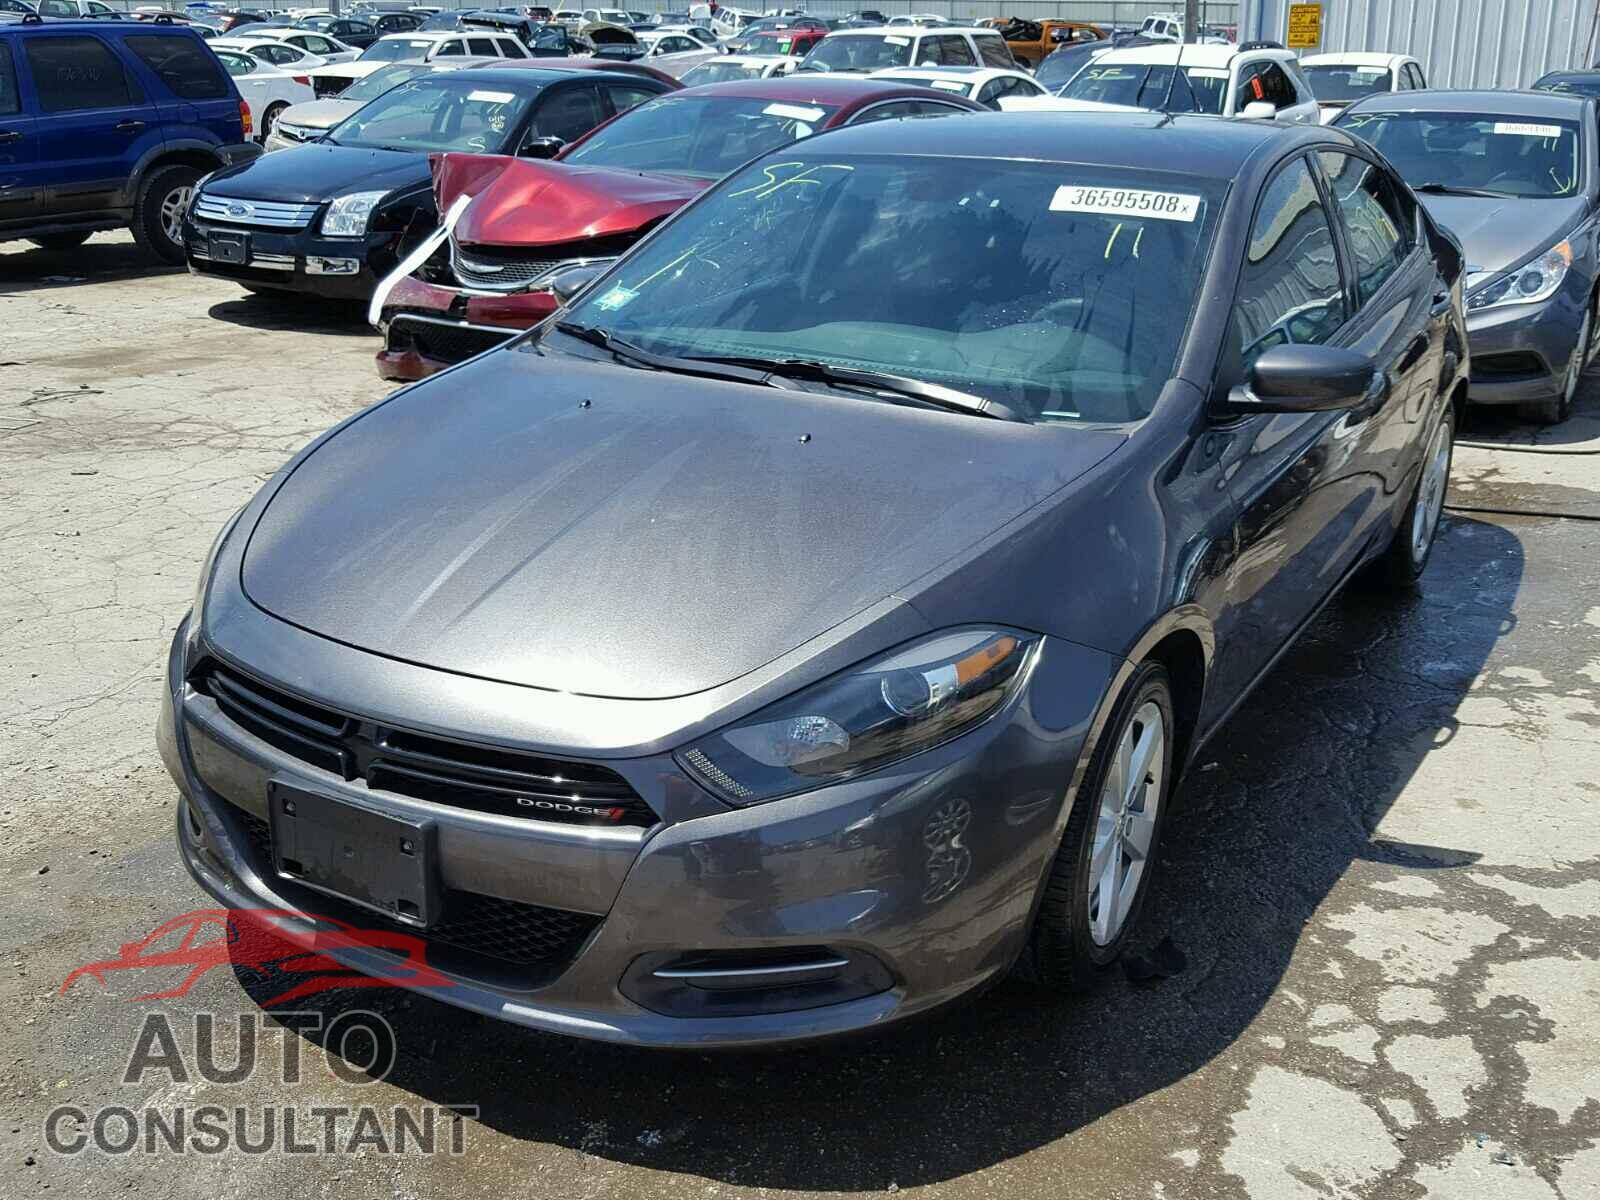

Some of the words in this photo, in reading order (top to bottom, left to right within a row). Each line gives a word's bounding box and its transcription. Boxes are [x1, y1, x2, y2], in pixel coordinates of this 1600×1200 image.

[1085, 67, 1123, 80] SF
[1342, 112, 1400, 129] SF
[727, 162, 856, 200] SF
[1071, 188, 1180, 213] 36595508
[516, 798, 610, 815] DODGE
